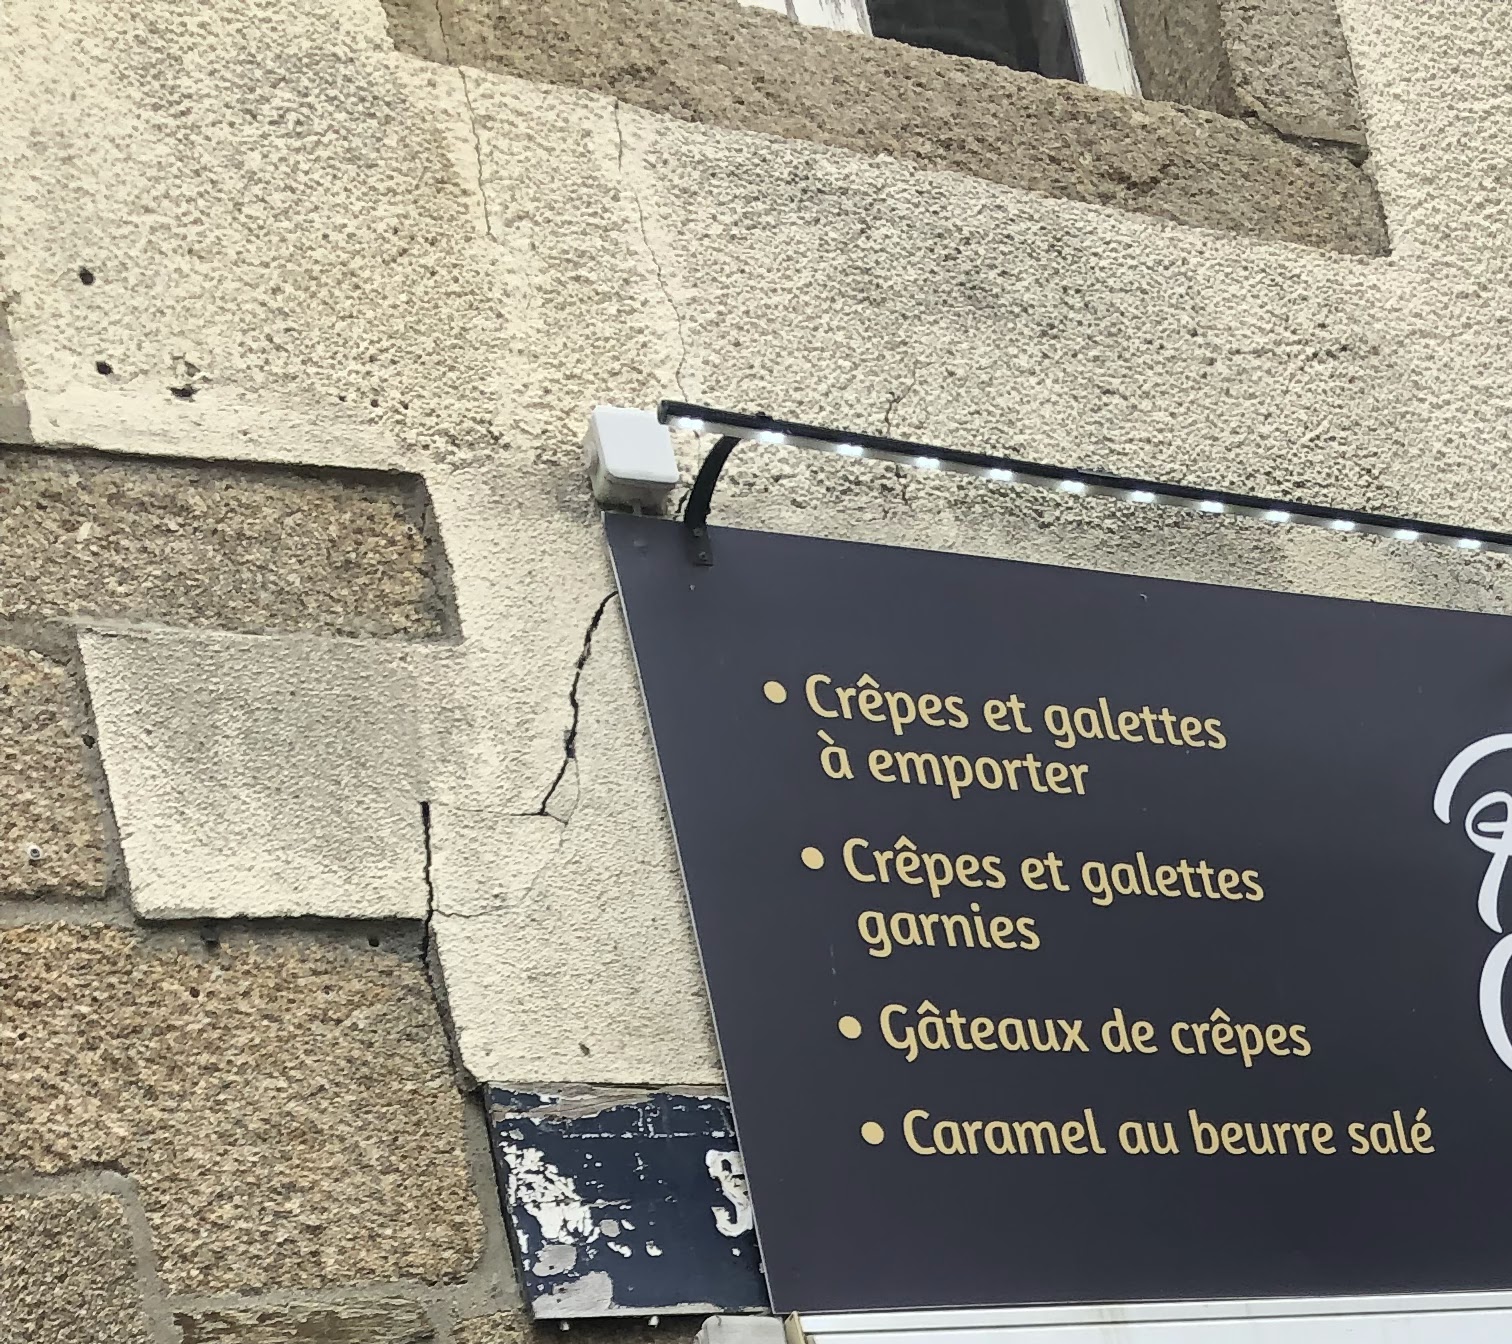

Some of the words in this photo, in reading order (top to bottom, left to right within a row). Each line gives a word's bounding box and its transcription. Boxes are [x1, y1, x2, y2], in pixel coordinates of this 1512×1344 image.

[806, 674, 968, 735] Crêpes
[984, 695, 1032, 732] et
[1045, 697, 1226, 749] galettes
[817, 730, 854, 779] à
[869, 747, 1088, 799] emporter
[843, 836, 1006, 898] Crêpes
[1021, 852, 1069, 891] et
[1082, 852, 1263, 905] galettes
[858, 903, 1040, 957] garnies
[881, 1000, 1089, 1062] Gâteaux
[1102, 1008, 1158, 1053] de
[1172, 1008, 1311, 1067] crêpes
[904, 1109, 1106, 1154] Caramel
[1118, 1117, 1181, 1155] au
[1189, 1110, 1336, 1154] beurre
[1348, 1108, 1435, 1154] salé
